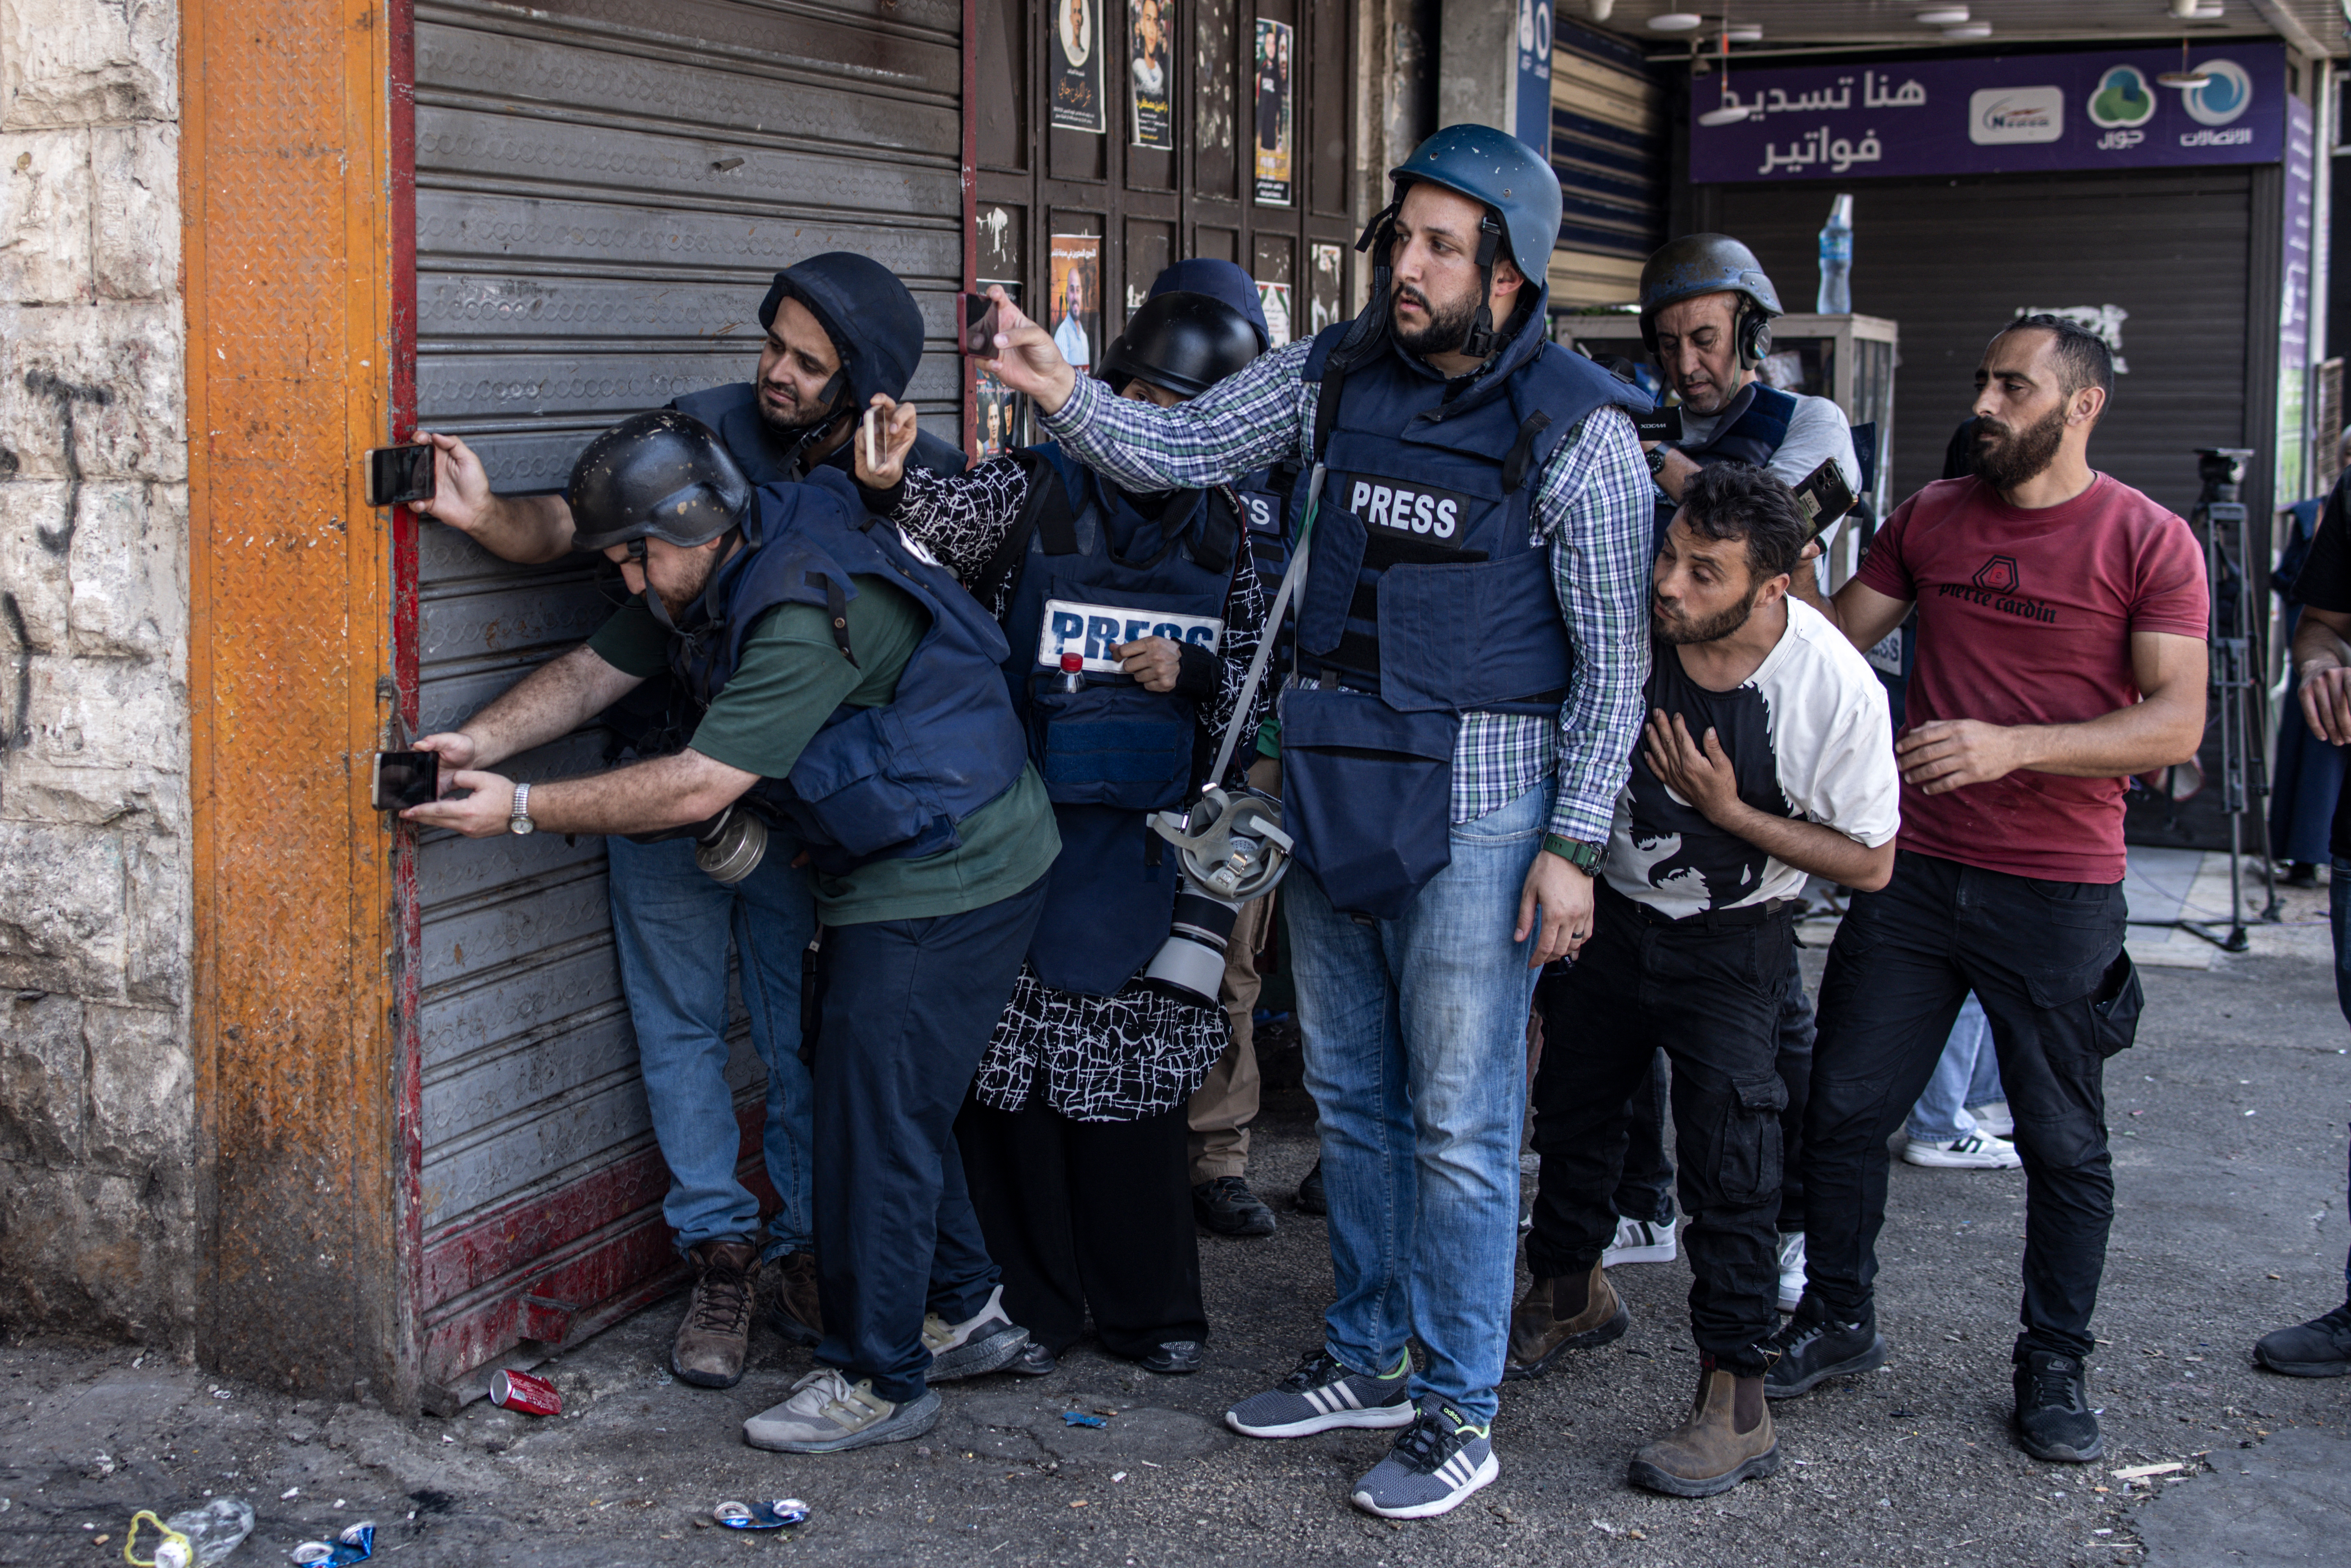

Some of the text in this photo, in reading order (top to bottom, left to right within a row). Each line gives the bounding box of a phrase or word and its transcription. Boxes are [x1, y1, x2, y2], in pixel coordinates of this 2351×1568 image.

[1863, 70, 1926, 108] هنا
[1758, 125, 1882, 175] فواتير
[2096, 128, 2146, 150] جوال
[2179, 127, 2253, 147] الاتصالات
[1220, 484, 1239, 514] Cano
[1239, 495, 1270, 525] S
[1350, 481, 1457, 538] PRESS
[1939, 584, 2057, 623] pierre cardin
[1444, 1408, 1462, 1425] adidas
